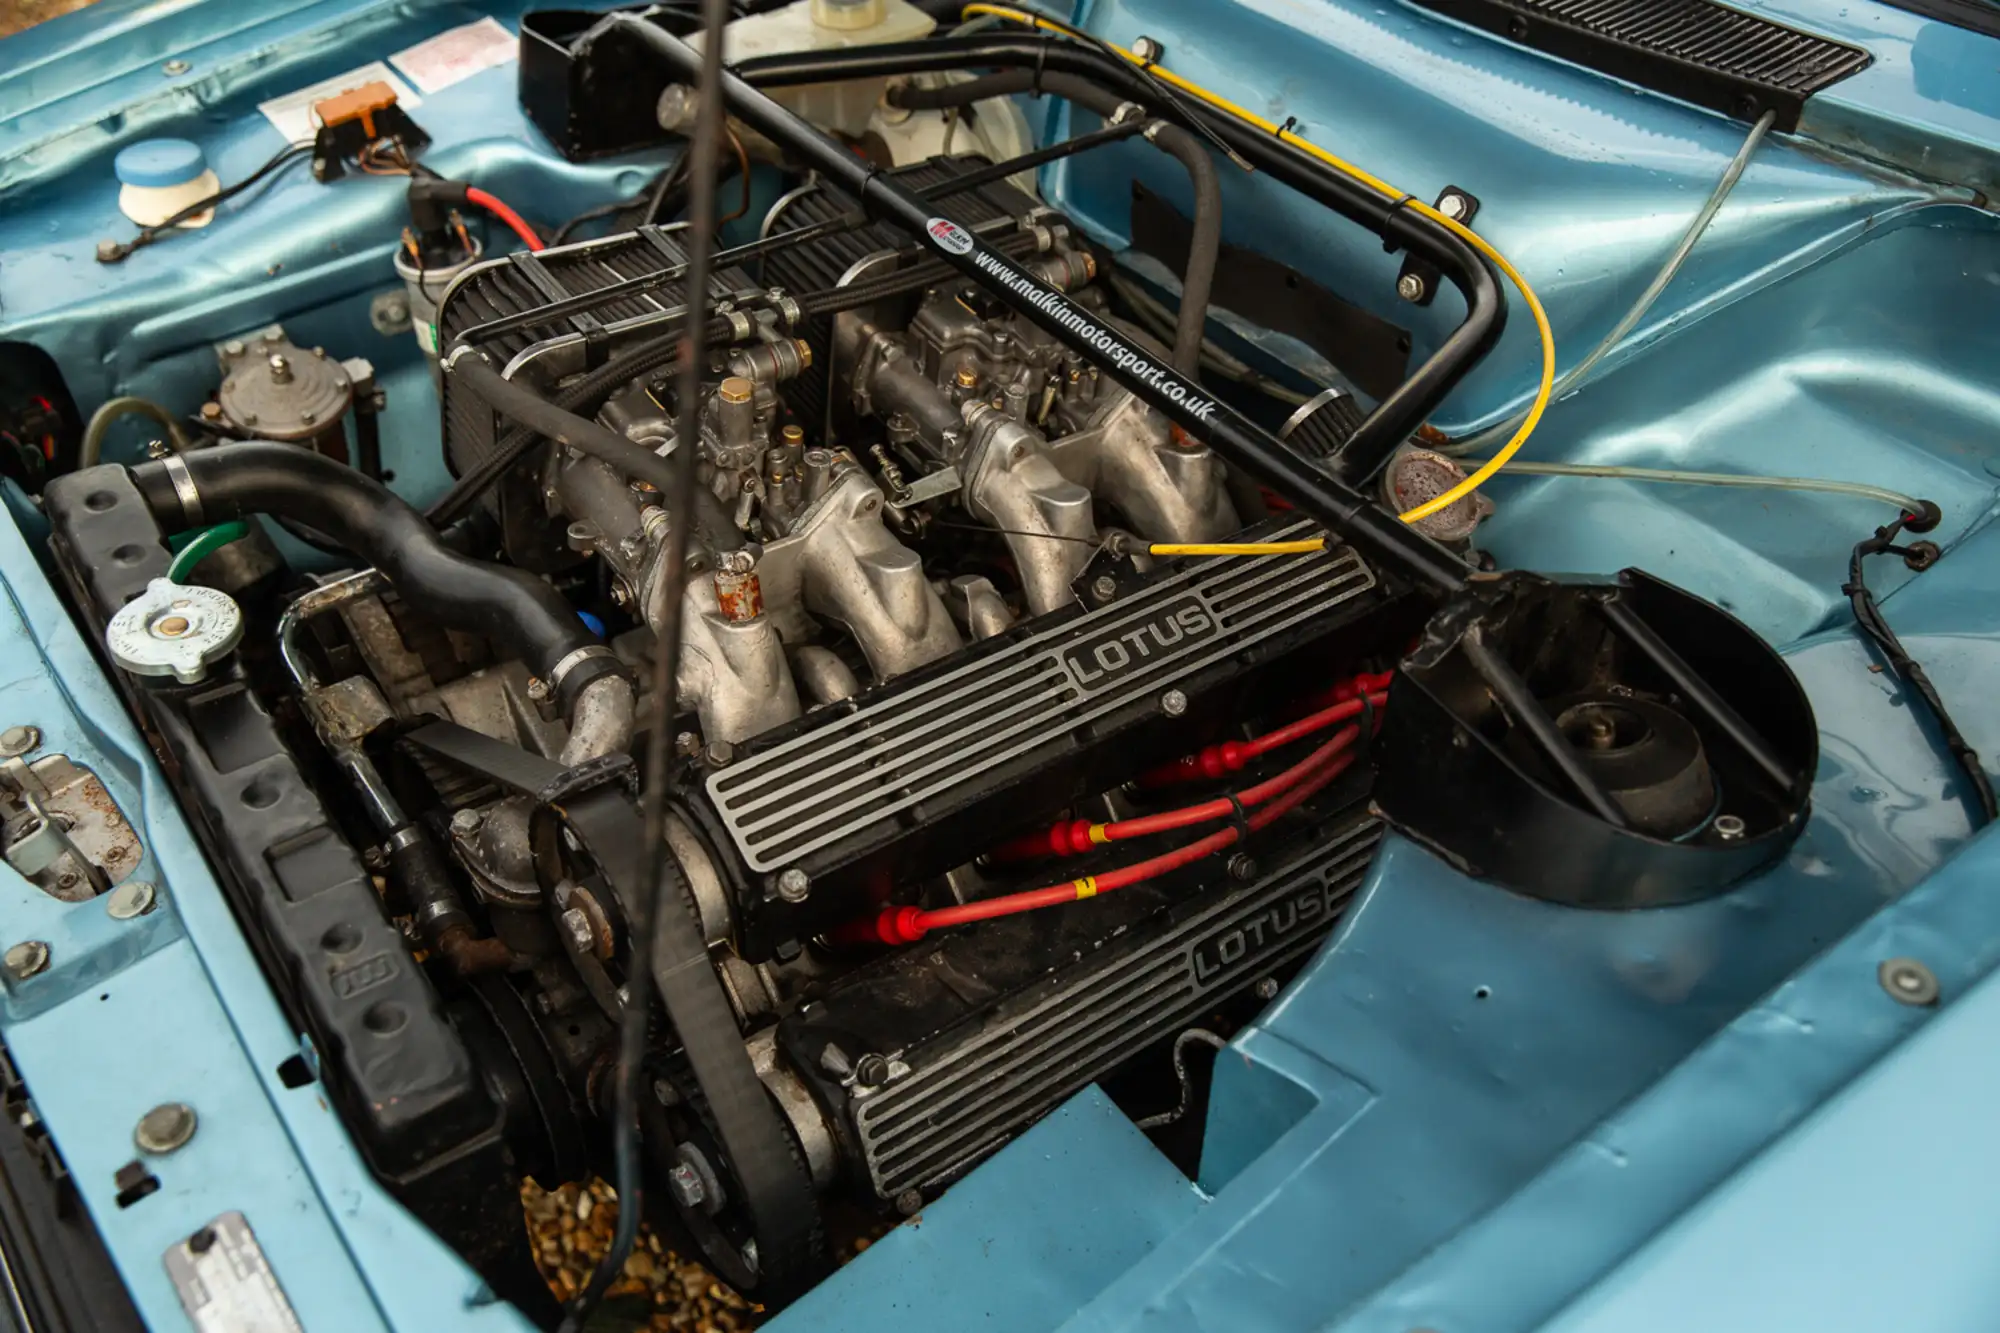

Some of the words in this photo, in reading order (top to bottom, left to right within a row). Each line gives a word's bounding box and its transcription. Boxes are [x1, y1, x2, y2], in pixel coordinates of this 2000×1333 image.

[974, 250, 1216, 421] www.malkinmotorsport.co.uk
[1068, 604, 1211, 684] LOTUS
[1195, 889, 1322, 979] LOTUS
